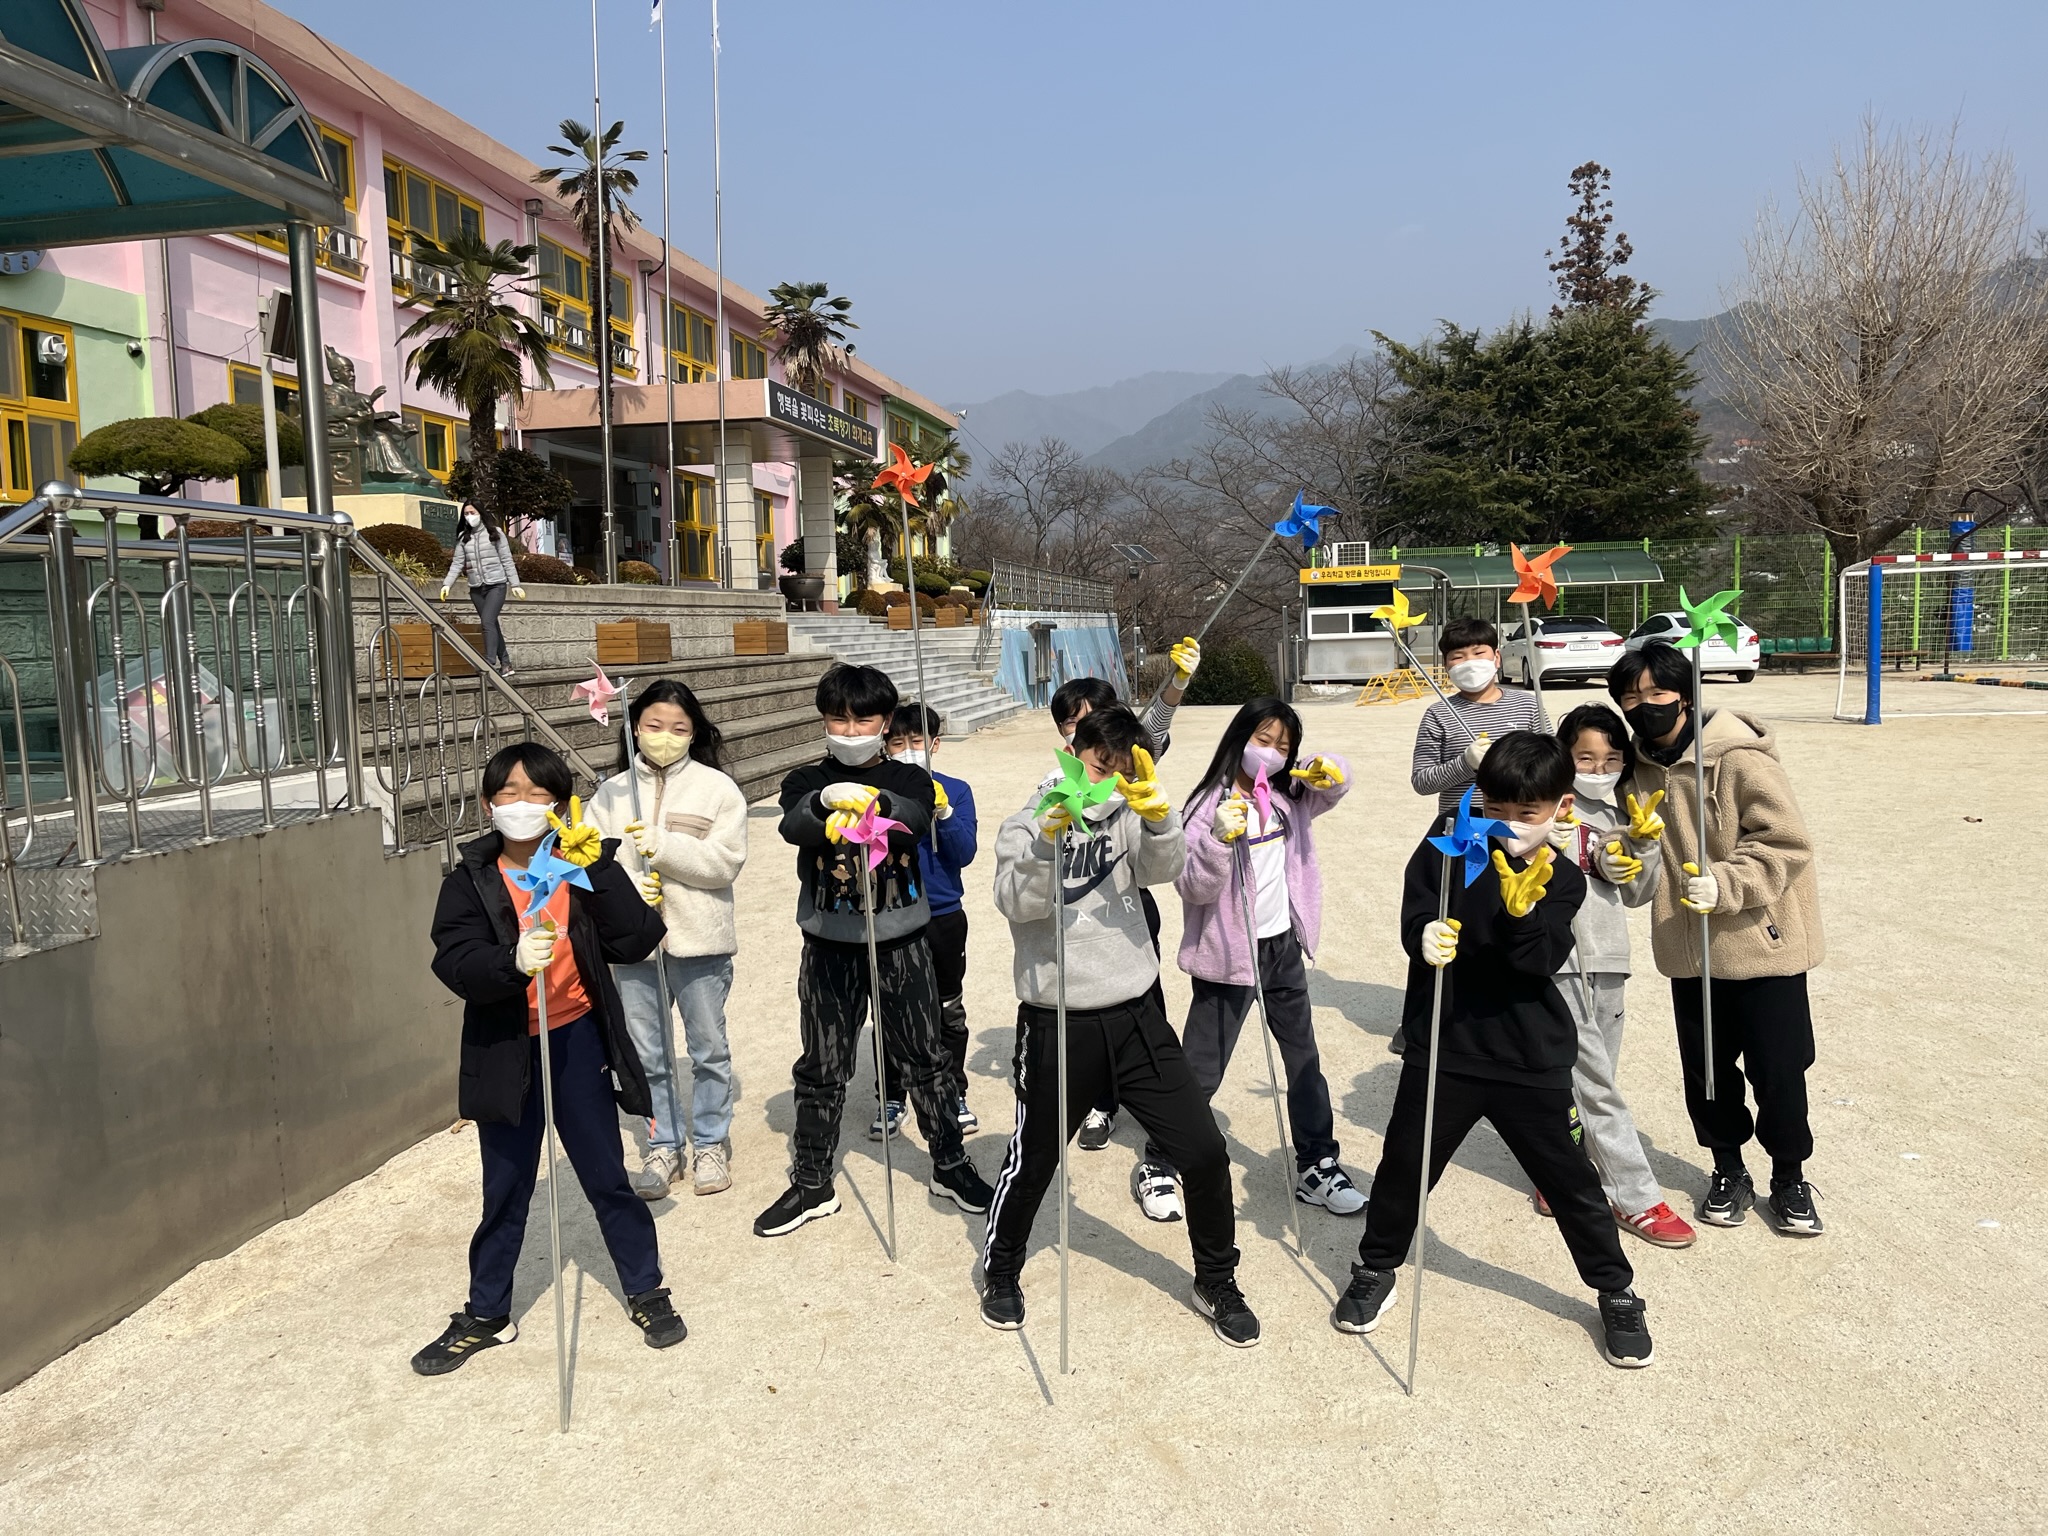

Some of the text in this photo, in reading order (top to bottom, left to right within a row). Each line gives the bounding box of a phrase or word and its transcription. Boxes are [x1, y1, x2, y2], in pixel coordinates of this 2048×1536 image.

[22, 255, 29, 271] 5
[776, 391, 799, 419] 행복을
[800, 401, 826, 430] 꽃피우는
[827, 412, 851, 440] 초록향기
[1320, 570, 1344, 579] 우리학교
[1076, 895, 1137, 926] AIR
